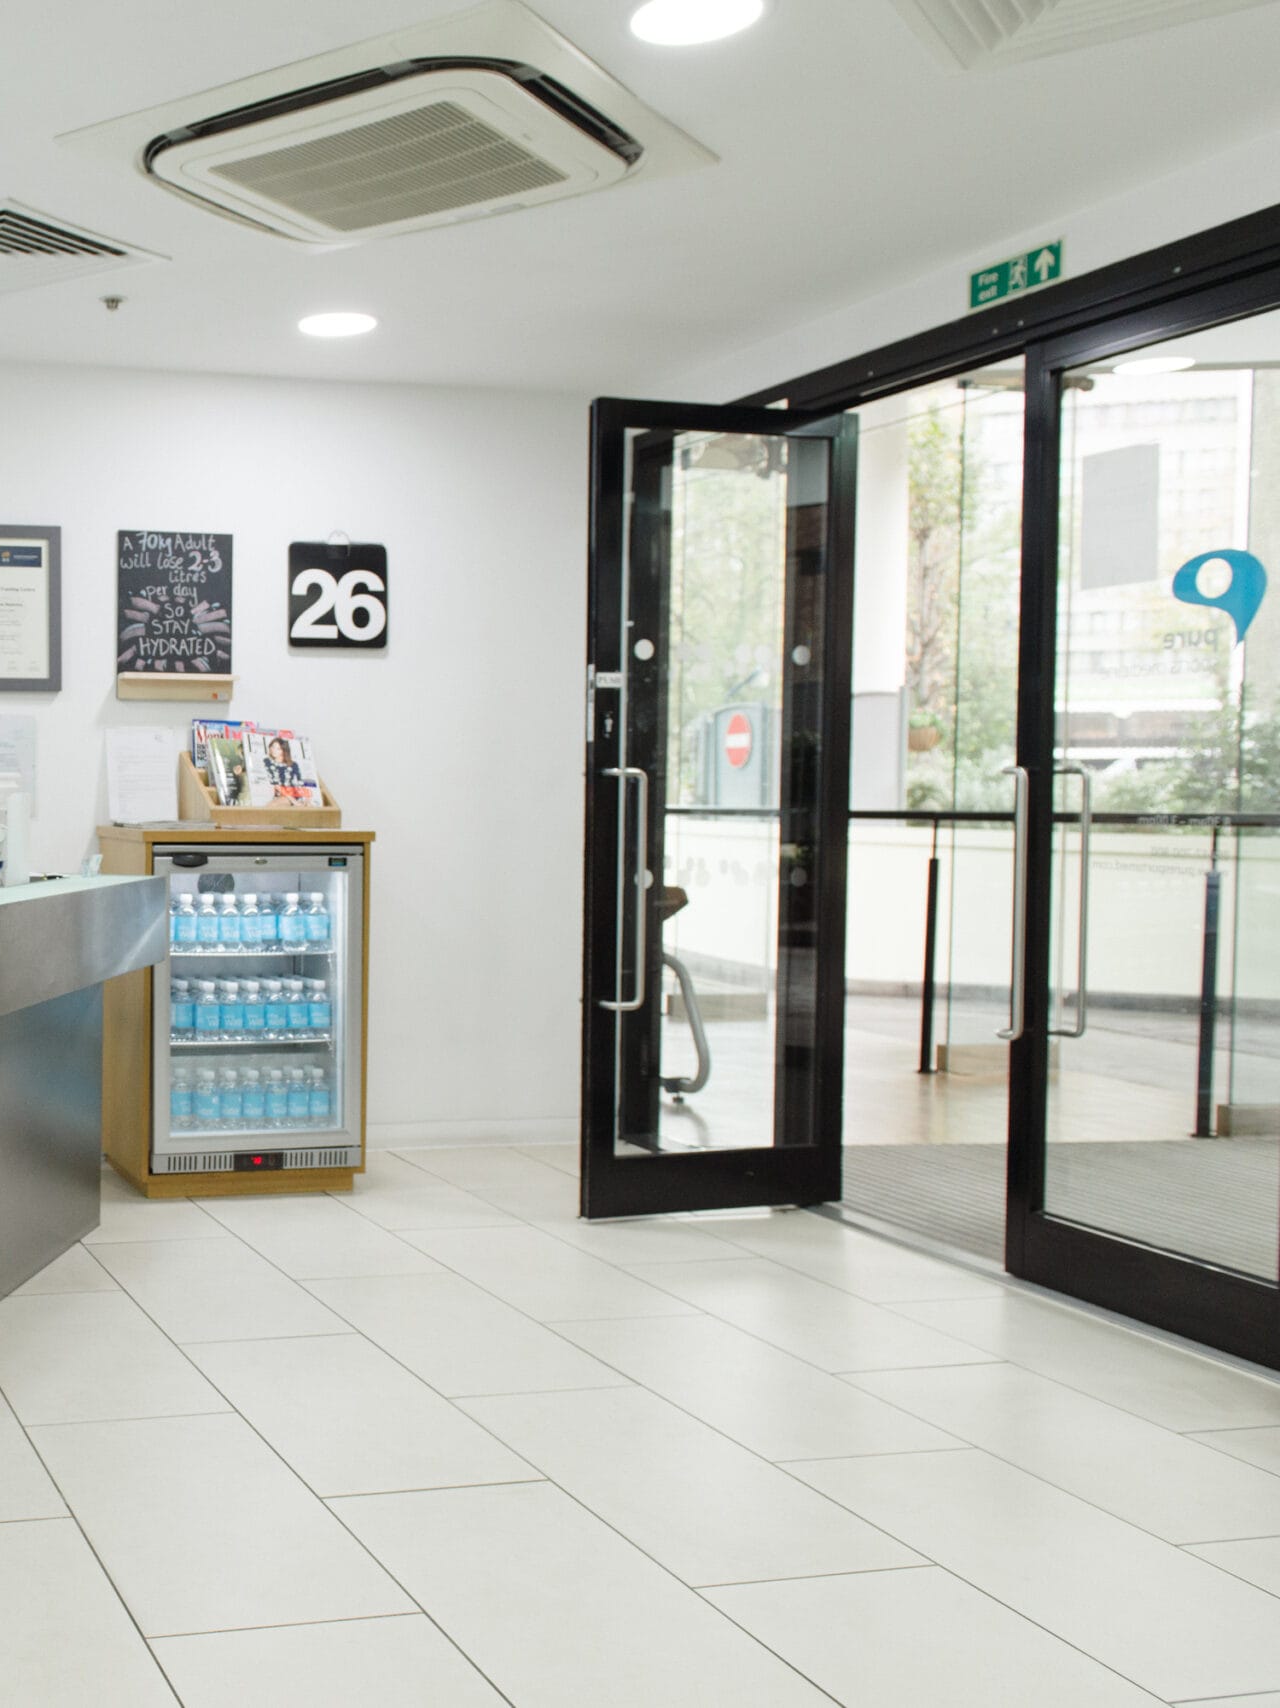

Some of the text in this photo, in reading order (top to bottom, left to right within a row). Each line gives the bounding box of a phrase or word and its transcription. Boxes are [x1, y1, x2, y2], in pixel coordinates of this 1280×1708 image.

[978, 272, 999, 287] Fire
[978, 285, 998, 301] exit
[123, 531, 216, 562] A 70kg Adult
[120, 552, 151, 569] will
[187, 550, 222, 573] 2-3
[146, 583, 198, 608] per day
[290, 568, 387, 642] 26
[151, 619, 190, 635] STAY
[139, 637, 216, 656] HYDRATED
